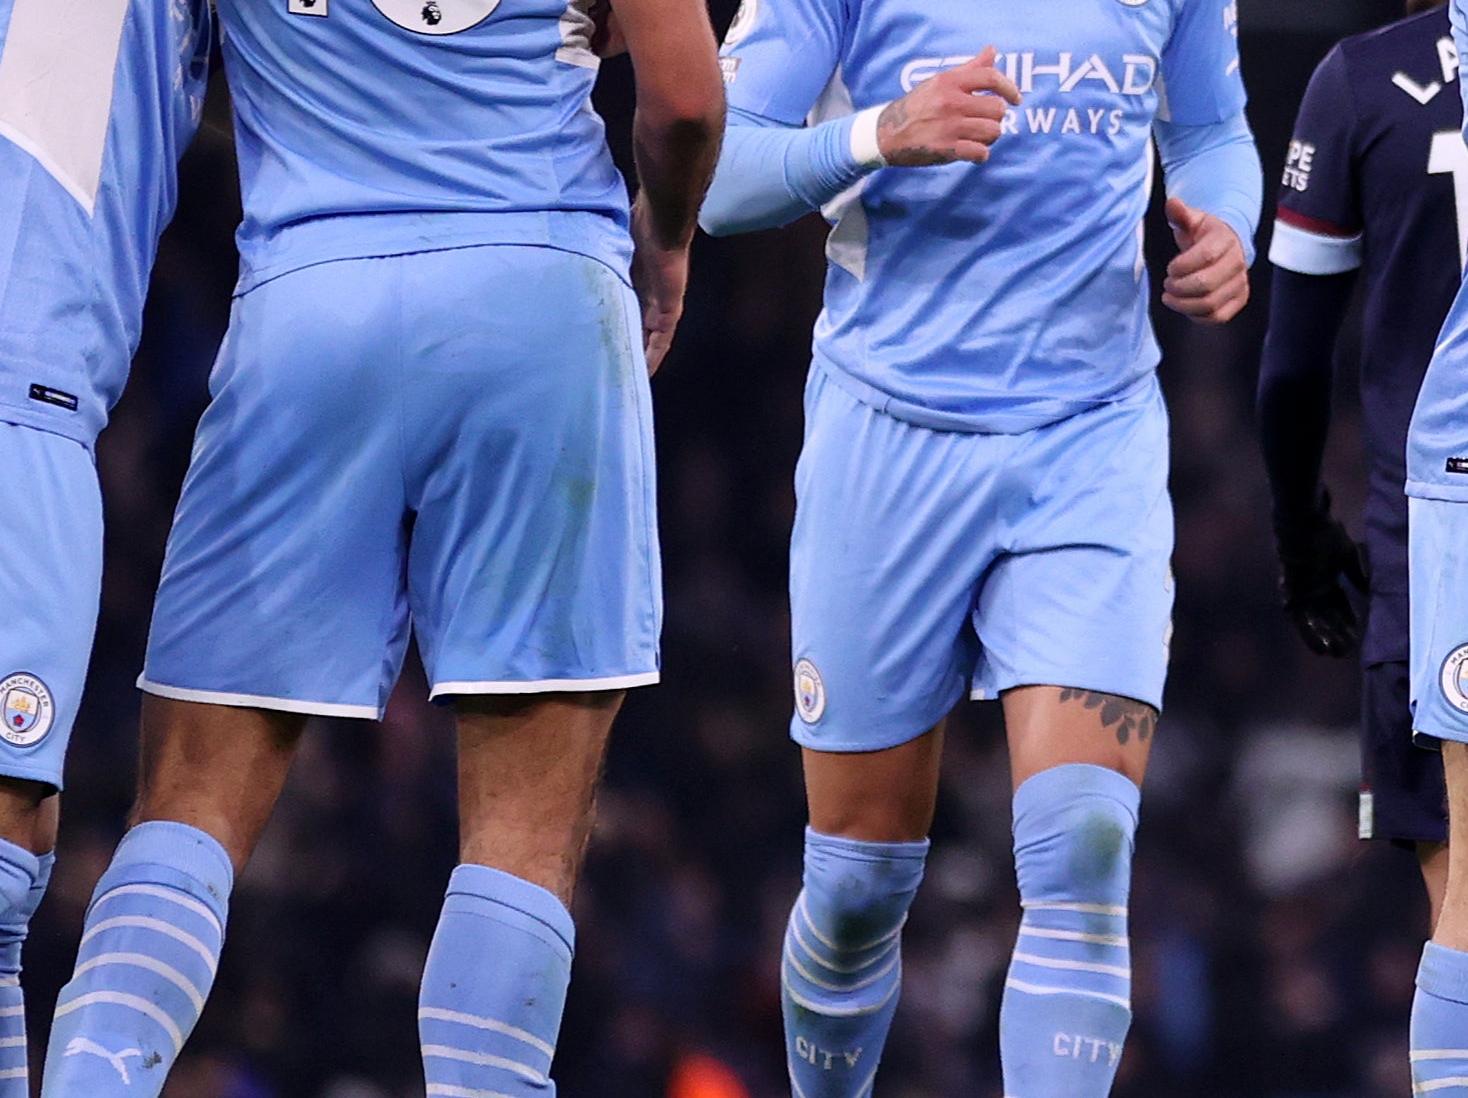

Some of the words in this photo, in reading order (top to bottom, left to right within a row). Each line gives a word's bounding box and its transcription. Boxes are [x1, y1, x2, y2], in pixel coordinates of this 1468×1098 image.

[1002, 107, 1123, 135] RWAYS
[0, 678, 49, 707] MANCHESTER
[5, 732, 26, 742] CITY
[796, 1035, 863, 1070] CITY
[1053, 1031, 1122, 1067] CITY
